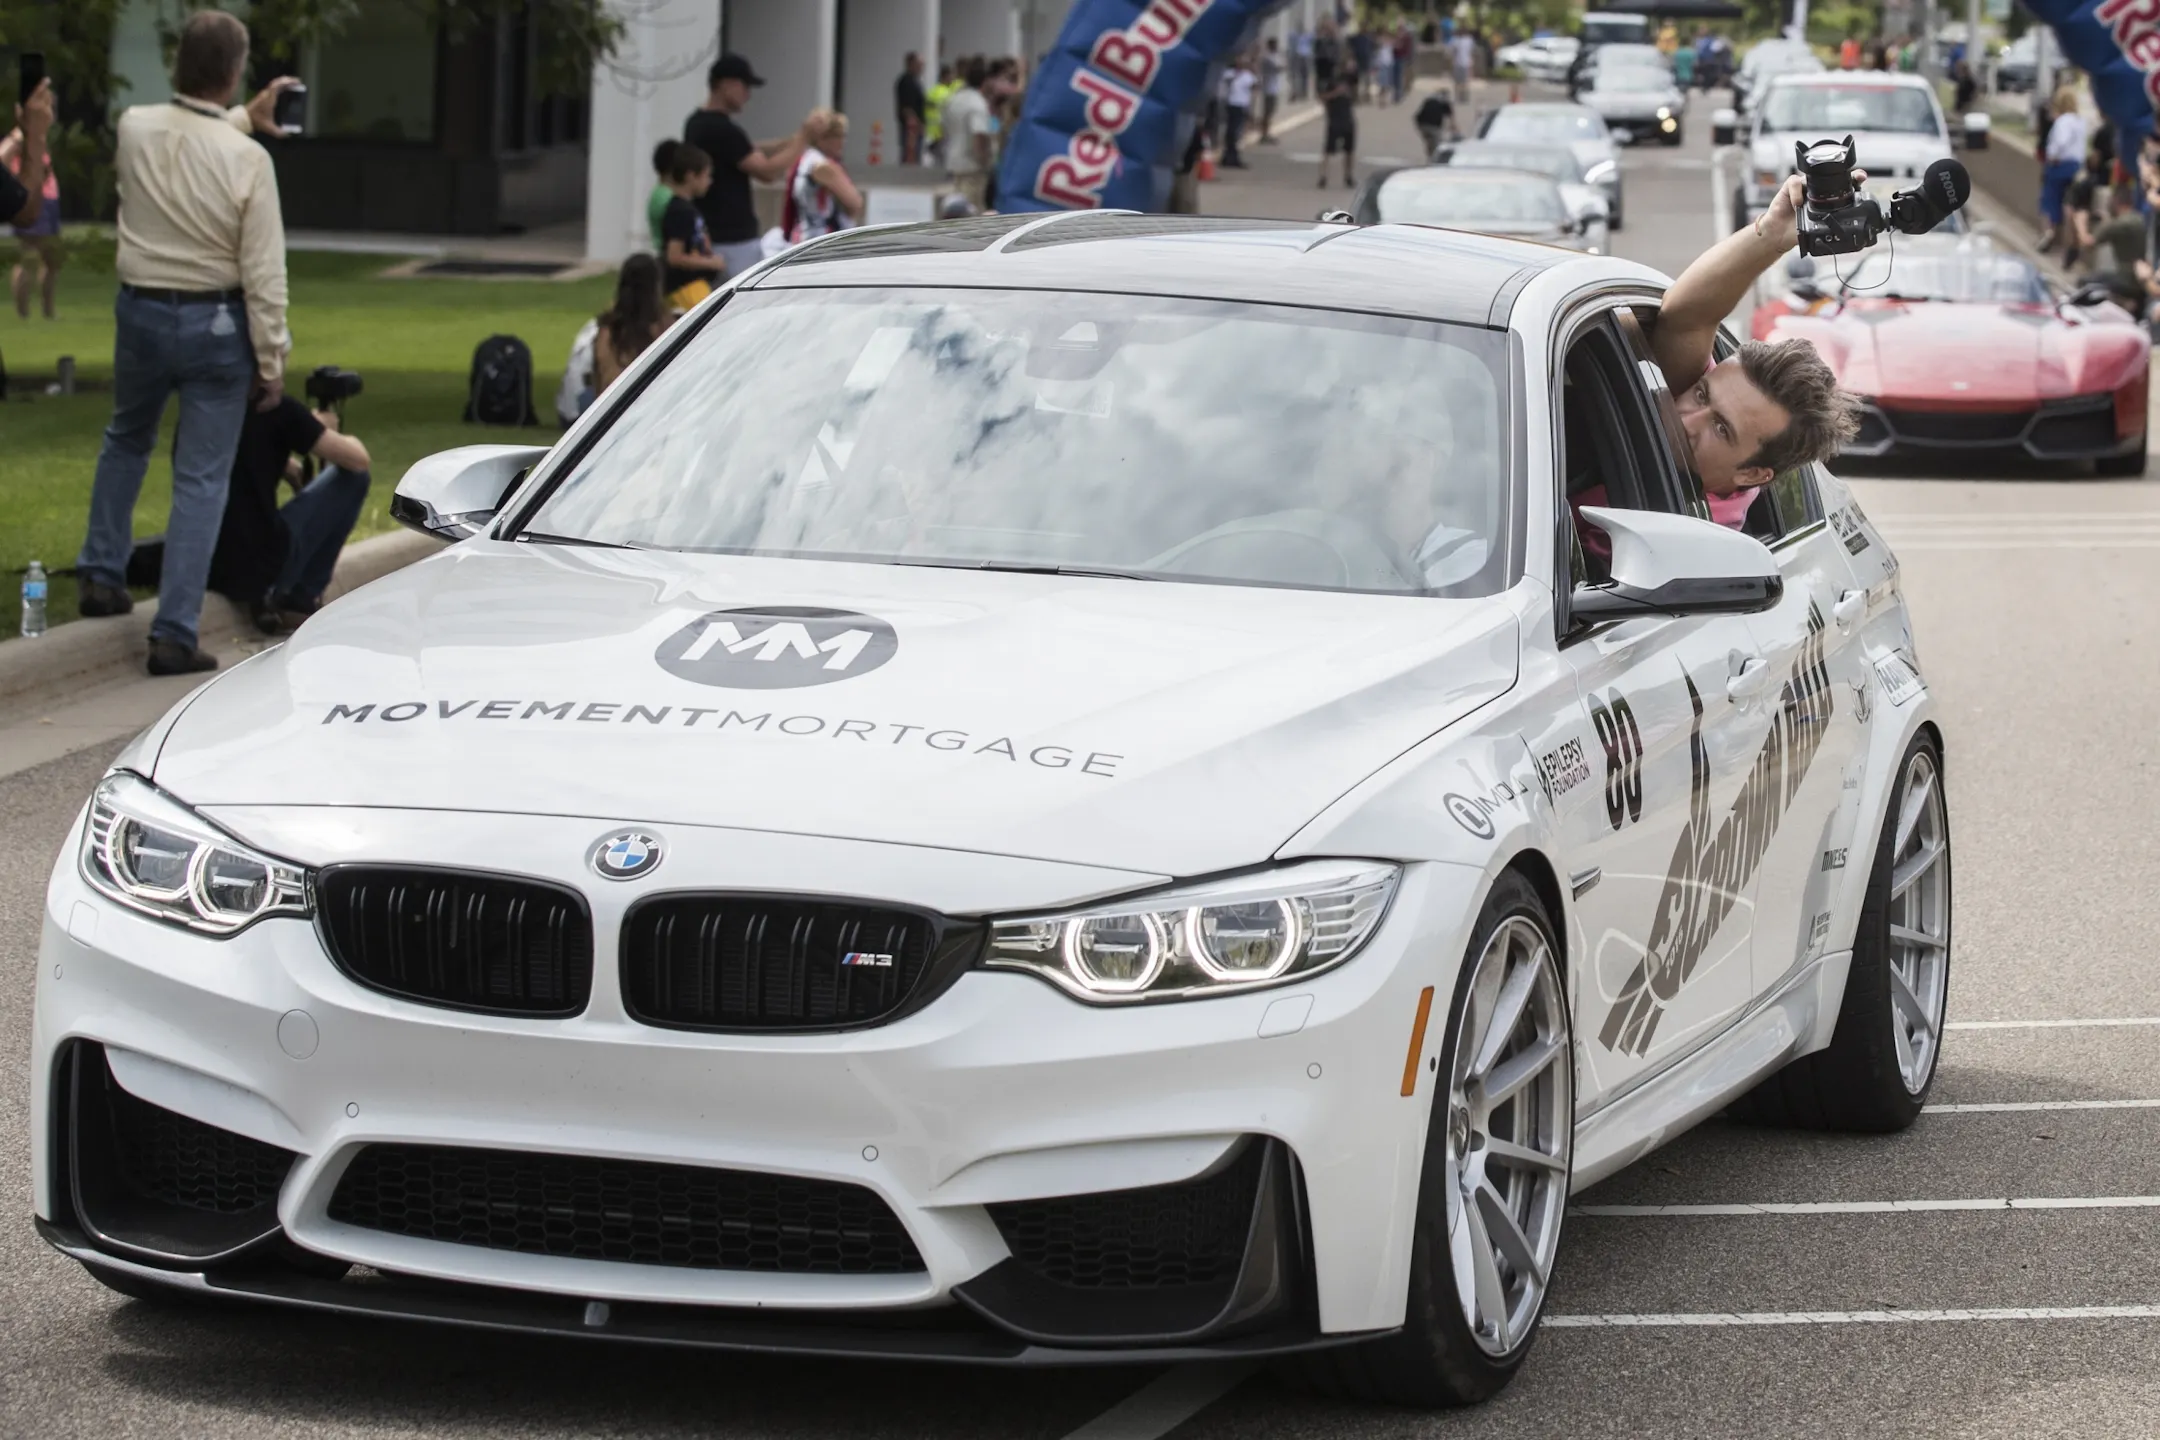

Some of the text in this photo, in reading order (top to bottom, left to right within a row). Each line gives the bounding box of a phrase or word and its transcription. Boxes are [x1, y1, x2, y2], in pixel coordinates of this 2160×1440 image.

[1034, 68, 1143, 209] Red
[1542, 736, 1585, 779] EPILEPSY
[1552, 761, 1591, 797] FOUNDATION
[1587, 686, 1643, 831] 80
[857, 952, 893, 967] M3
[1665, 925, 1684, 979] 2016
